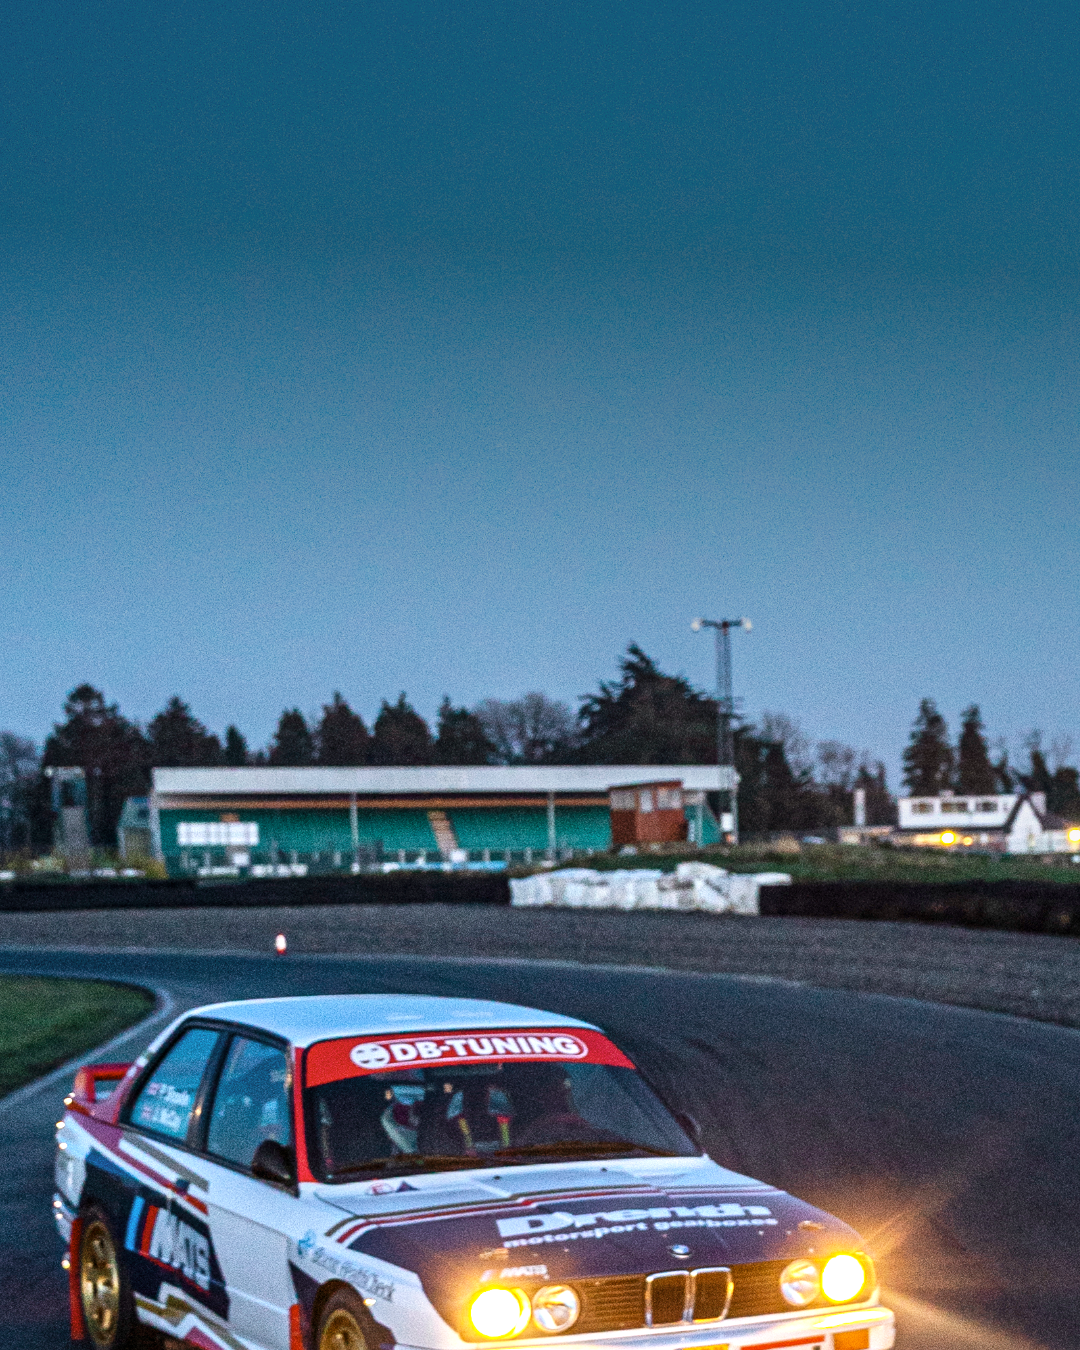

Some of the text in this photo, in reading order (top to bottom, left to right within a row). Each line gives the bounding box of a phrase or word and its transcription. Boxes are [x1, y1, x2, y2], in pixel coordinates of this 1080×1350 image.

[390, 1035, 580, 1061] DB-TUNING
[496, 1203, 773, 1238] Drenth
[503, 1218, 778, 1248] motorsport gearboxes
